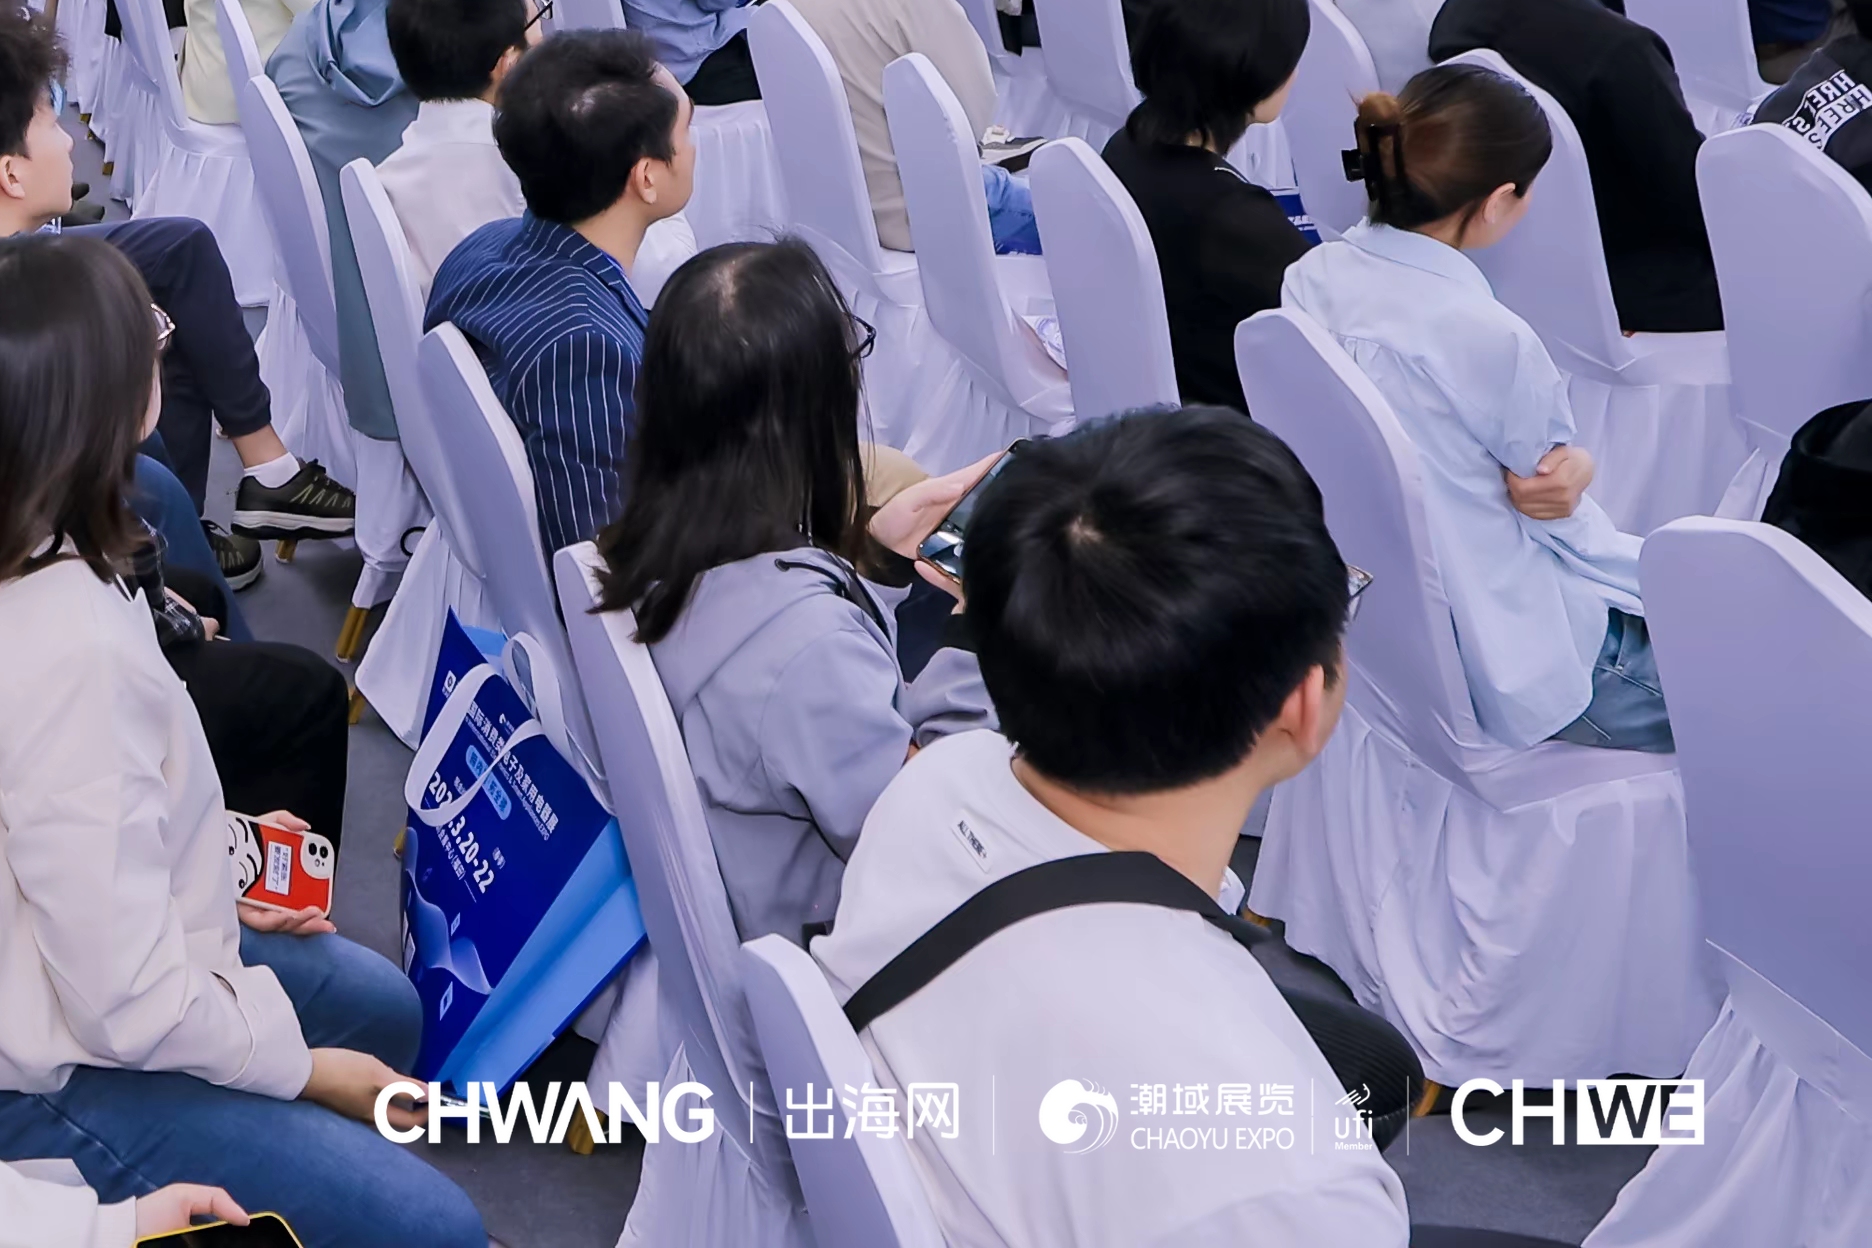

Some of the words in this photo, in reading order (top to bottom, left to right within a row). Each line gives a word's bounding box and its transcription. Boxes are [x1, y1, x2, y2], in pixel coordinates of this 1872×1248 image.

[427, 772, 495, 894] 202.3.20-22
[435, 825, 466, 881] 会展中心(福田)
